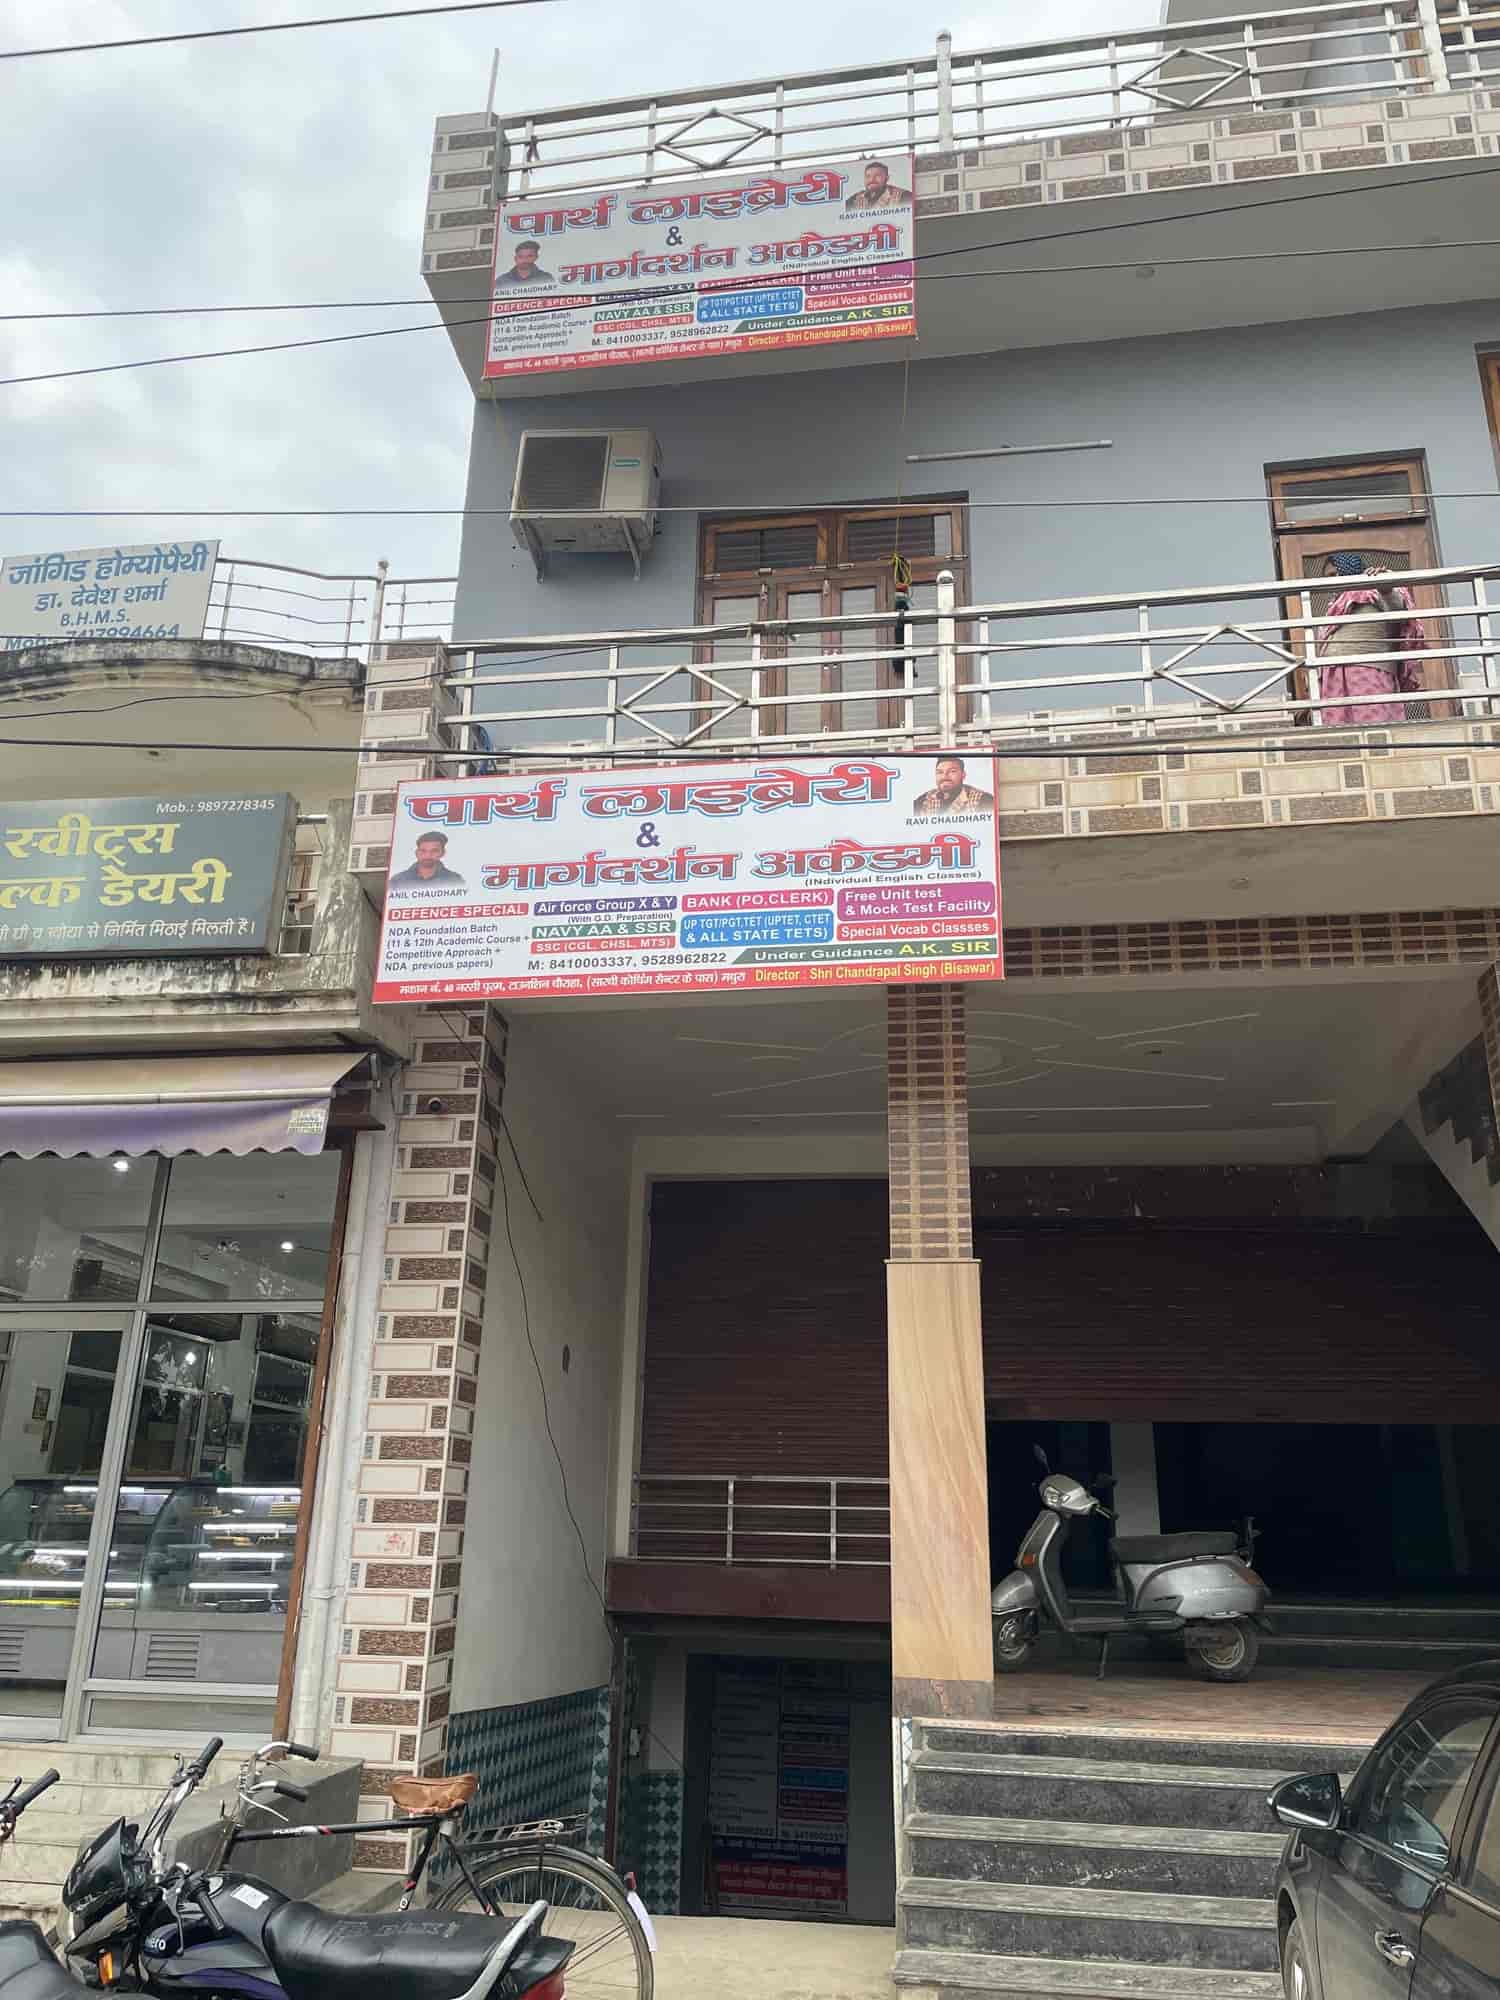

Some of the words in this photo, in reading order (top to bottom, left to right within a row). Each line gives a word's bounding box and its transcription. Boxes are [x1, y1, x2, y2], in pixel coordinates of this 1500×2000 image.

[504, 192, 618, 236] पार्थ
[625, 168, 849, 224] लाइब्रेरी
[859, 207, 911, 219] CHAUDHARY
[666, 226, 683, 246] &
[558, 242, 737, 286] मार्गदर्शन
[496, 301, 544, 312] DEFENCE
[546, 296, 591, 306] SPECIAL
[597, 310, 629, 321] NAVY
[632, 306, 650, 317] AA
[664, 303, 691, 314] SSR
[734, 304, 766, 315] STATE
[748, 320, 783, 330] Under
[787, 315, 843, 326] Guidance
[881, 305, 909, 316] SIR
[8, 552, 92, 585] जांगिड
[95, 542, 210, 582] होम्योपैथी
[71, 584, 120, 607] देवेश
[123, 577, 170, 603] शर्मा
[60, 609, 131, 627] B.H.M.S.
[405, 777, 568, 826] पार्थ
[580, 761, 900, 818] लाइब्रेरी
[198, 799, 275, 812] 9897278345
[905, 816, 928, 827] RAVI
[931, 813, 993, 825] CHAUDHARY
[635, 821, 661, 849] &
[480, 845, 743, 891] मार्गदर्शन
[99, 857, 233, 907] डेयरी
[876, 873, 924, 885] English
[927, 871, 983, 882] Classes)
[389, 890, 409, 899] ANIL
[411, 888, 468, 899] CHAUDHARY
[845, 890, 877, 902] Free
[881, 889, 913, 901] Unit
[915, 887, 942, 899] test
[538, 903, 557, 913] Air
[560, 901, 592, 912] force
[595, 900, 635, 912] Group
[639, 898, 648, 909] X
[651, 897, 660, 908] &
[665, 896, 674, 907] Y
[687, 896, 732, 909] BANK
[845, 905, 856, 916] &
[860, 903, 899, 915] Mock
[904, 901, 933, 913] Test
[938, 900, 992, 913] Facility
[391, 906, 460, 920] DEFENCE
[463, 903, 525, 917] SPECIAL
[568, 914, 592, 924] (With
[616, 911, 673, 923] Preparation)
[103, 919, 146, 937] निर्मित
[191, 917, 234, 935] मिलती
[389, 927, 411, 937] NDA
[413, 924, 467, 936] Foundation
[470, 923, 498, 934] Batch
[536, 925, 583, 938] NAVY
[587, 924, 613, 936] AA
[617, 923, 629, 935] &
[634, 921, 671, 934] SSR
[684, 919, 697, 930] UP
[804, 913, 830, 925] CTET
[685, 932, 696, 943] &
[700, 931, 729, 943] ALL
[733, 928, 780, 941] STATE
[784, 926, 828, 940] TETS)
[841, 925, 887, 939] Special
[890, 923, 928, 936] Vocab
[415, 937, 434, 948] 12th
[436, 935, 485, 947] Academic
[487, 934, 521, 944] Course
[536, 942, 561, 953] SSC
[640, 937, 671, 950] MTS)
[386, 948, 443, 961] Competitive
[445, 946, 493, 959] Approach
[754, 950, 807, 962] Under
[811, 947, 893, 959] Guidance
[899, 942, 944, 955] A.K.
[951, 940, 991, 953] SIR
[385, 962, 408, 972] NDA
[412, 959, 454, 971] previous
[456, 958, 494, 970] papers)
[528, 960, 545, 971] M:
[641, 952, 728, 967] 9528962822
[755, 968, 800, 982] Director
[809, 966, 833, 980] Shri
[836, 963, 900, 981] Chandrapal
[903, 962, 937, 978] Singh
[940, 960, 995, 976] (Bisawar)
